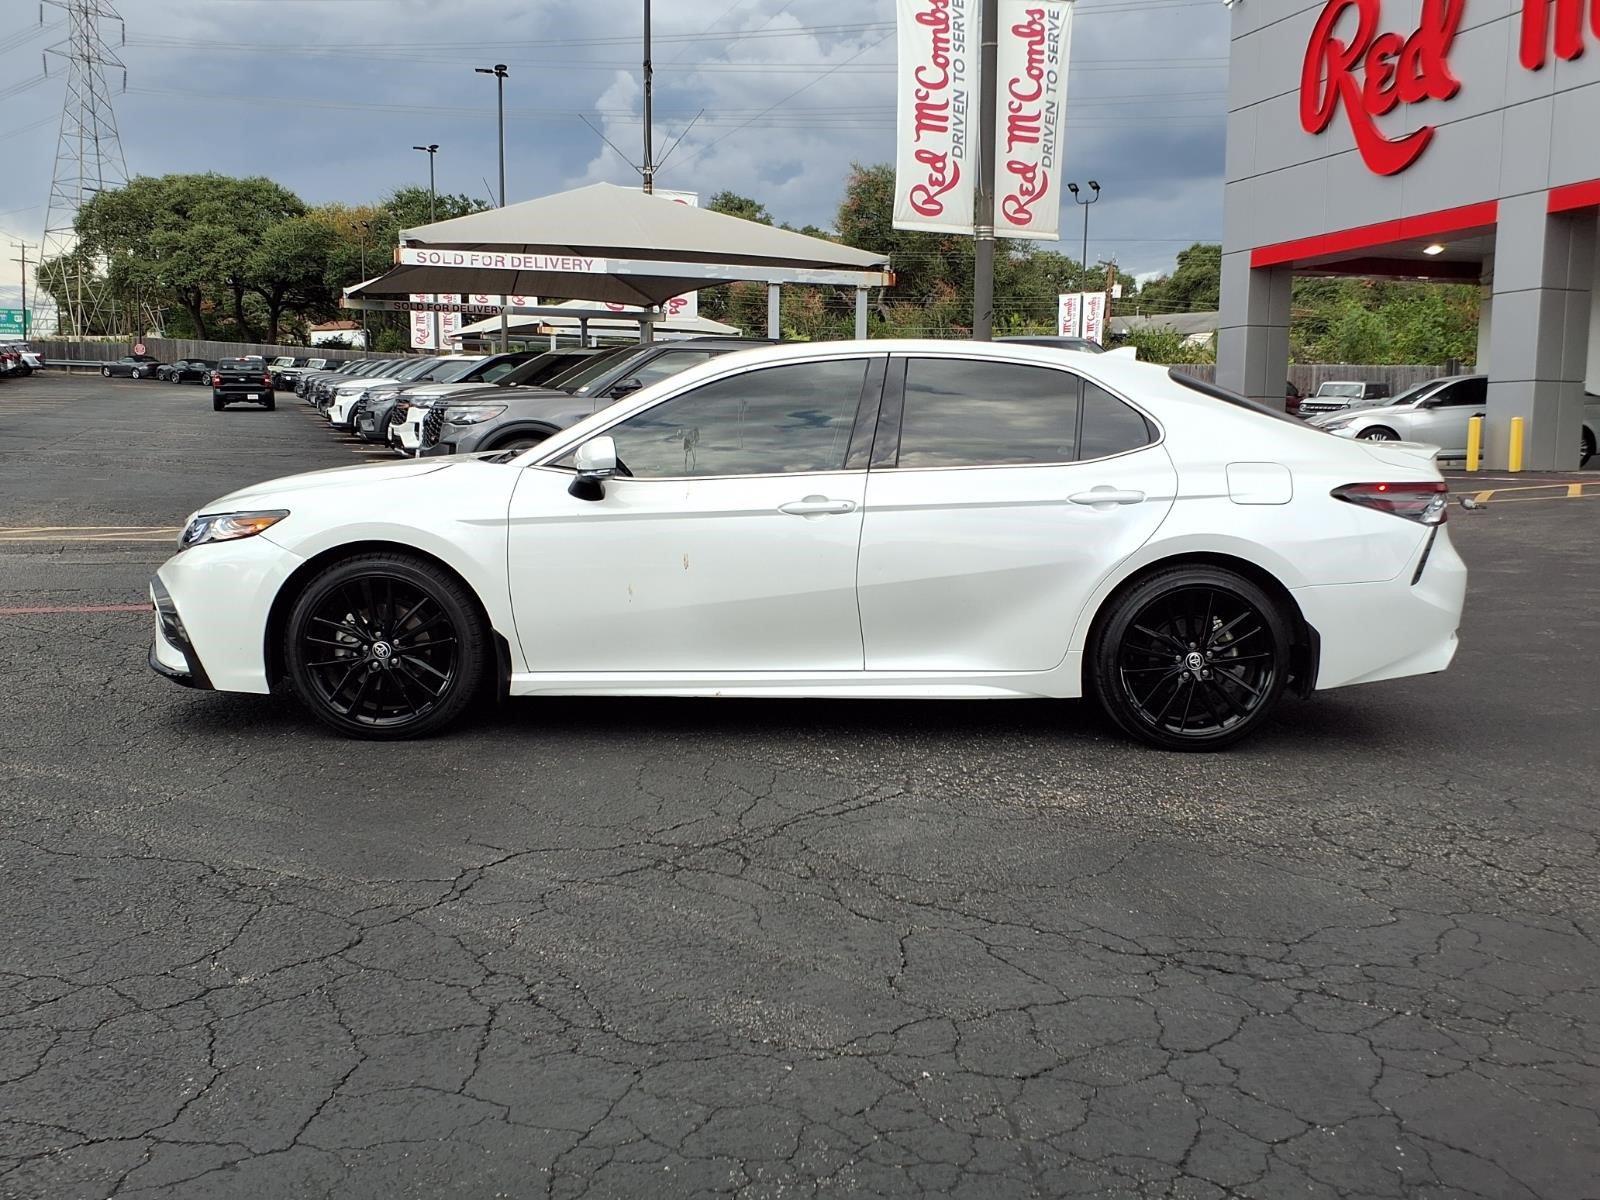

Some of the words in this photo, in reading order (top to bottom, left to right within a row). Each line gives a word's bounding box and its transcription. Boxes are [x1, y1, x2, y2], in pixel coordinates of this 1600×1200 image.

[953, 0, 965, 54] SERVE
[1047, 9, 1060, 65] SERVE
[914, 0, 950, 143] McCombs
[953, 58, 966, 84] TO
[1005, 8, 1046, 154] McCombs
[1046, 70, 1058, 95] TO
[1299, 0, 1467, 176] Red
[952, 89, 965, 160] DRIVEN
[1042, 101, 1056, 169] DRIVEN
[909, 149, 960, 217] Red
[1002, 160, 1048, 226] Red
[416, 251, 464, 266] SOLD
[470, 254, 506, 268] FOR
[511, 256, 594, 271] DELIVERY
[394, 301, 424, 312] SOLD
[427, 303, 450, 313] FOR
[452, 304, 505, 315] DELIVERY
